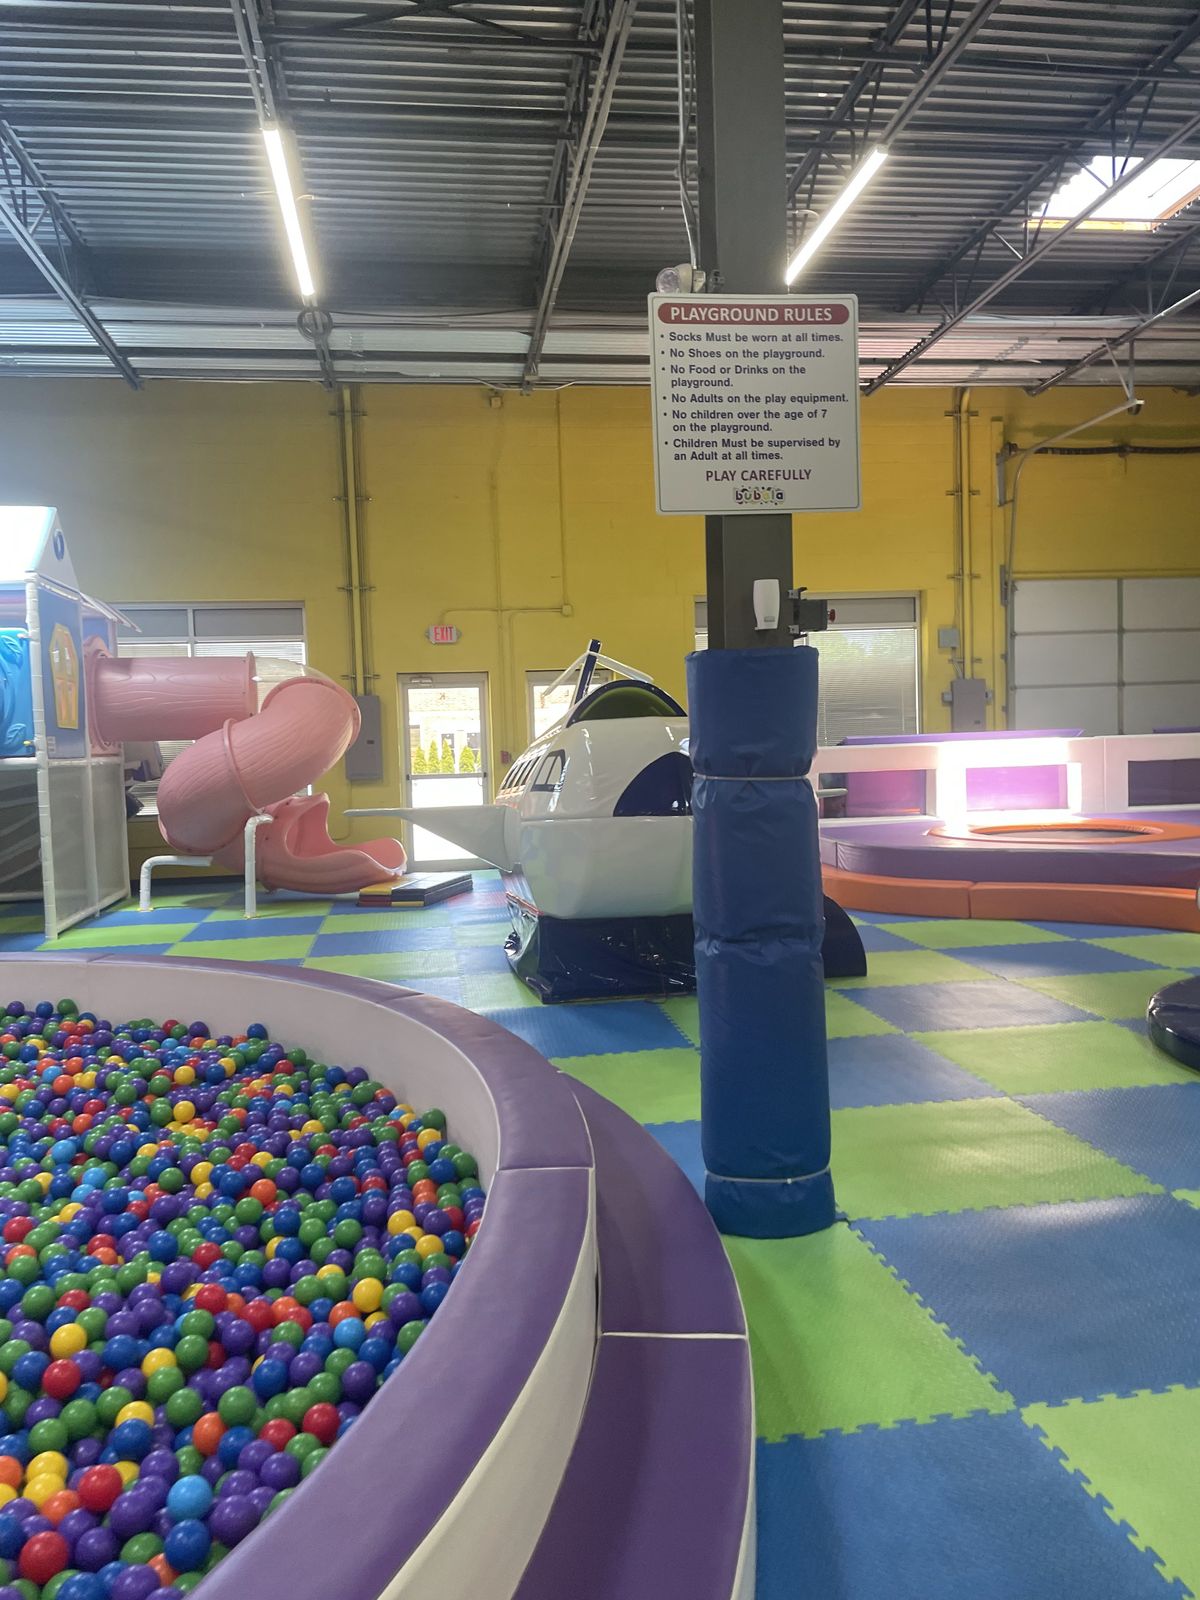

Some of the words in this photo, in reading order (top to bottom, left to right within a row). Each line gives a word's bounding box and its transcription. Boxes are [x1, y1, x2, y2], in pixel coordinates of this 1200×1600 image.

[670, 307, 778, 322] PLAYGROUND
[784, 308, 832, 321] RULES
[669, 332, 702, 342] Socks
[706, 333, 731, 342] Must
[735, 333, 748, 342] be
[782, 334, 792, 342] at
[796, 333, 808, 342] all
[811, 333, 843, 342] times.
[670, 349, 684, 358] No
[688, 349, 721, 358] Shoes
[742, 349, 759, 358] the
[763, 349, 825, 360] playground.
[670, 366, 685, 374] No
[689, 366, 715, 374] Food
[735, 365, 768, 374] Drinks
[789, 366, 805, 374] the
[671, 379, 733, 389] playground.
[672, 394, 686, 403] No
[690, 394, 723, 403] Adults
[744, 394, 760, 403] the
[765, 394, 786, 404] play
[790, 394, 848, 404] equipment.
[672, 410, 686, 419] No
[691, 410, 733, 419] children
[764, 410, 780, 419] the
[784, 412, 803, 420] age
[807, 410, 818, 418] of
[821, 410, 827, 418] 7
[690, 423, 706, 432] the
[711, 423, 772, 433] playground.
[673, 439, 717, 448] Children
[722, 439, 747, 448] Must
[751, 438, 764, 447] be
[768, 438, 824, 448] supervised
[828, 438, 840, 448] by
[690, 452, 718, 460] Adult
[722, 452, 732, 460] at
[736, 452, 748, 460] all
[752, 451, 783, 460] times.
[706, 471, 736, 481] PLAY
[741, 469, 811, 481] CAREFULLY
[433, 626, 453, 641] EXIT
